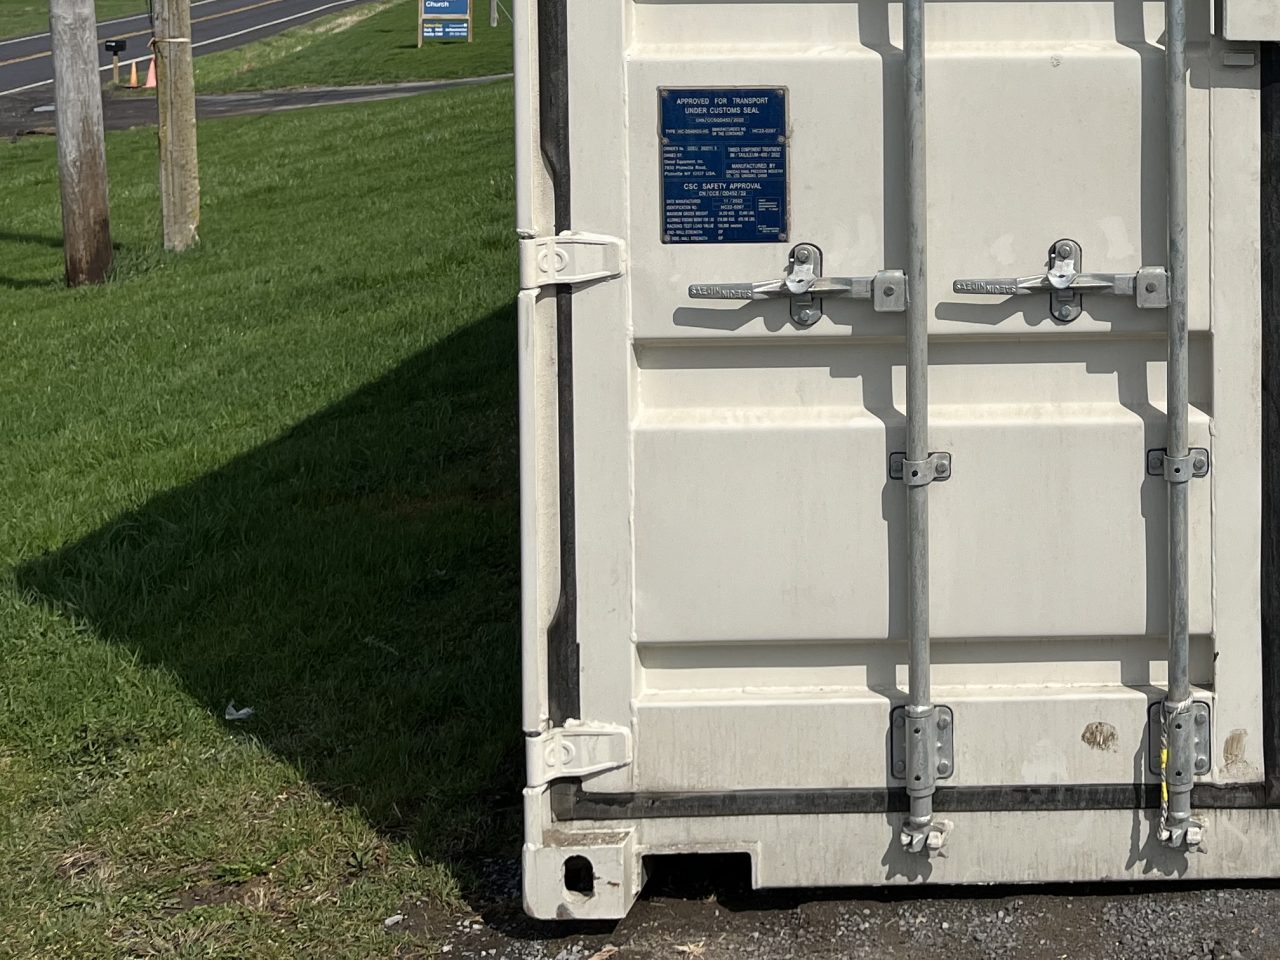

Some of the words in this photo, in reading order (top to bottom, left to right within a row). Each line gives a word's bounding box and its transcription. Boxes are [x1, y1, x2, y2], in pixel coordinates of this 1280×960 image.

[676, 97, 710, 105] APPROVED
[714, 97, 728, 105] FOR
[732, 97, 769, 105] TRANSPORT
[702, 182, 727, 190] SAFETY
